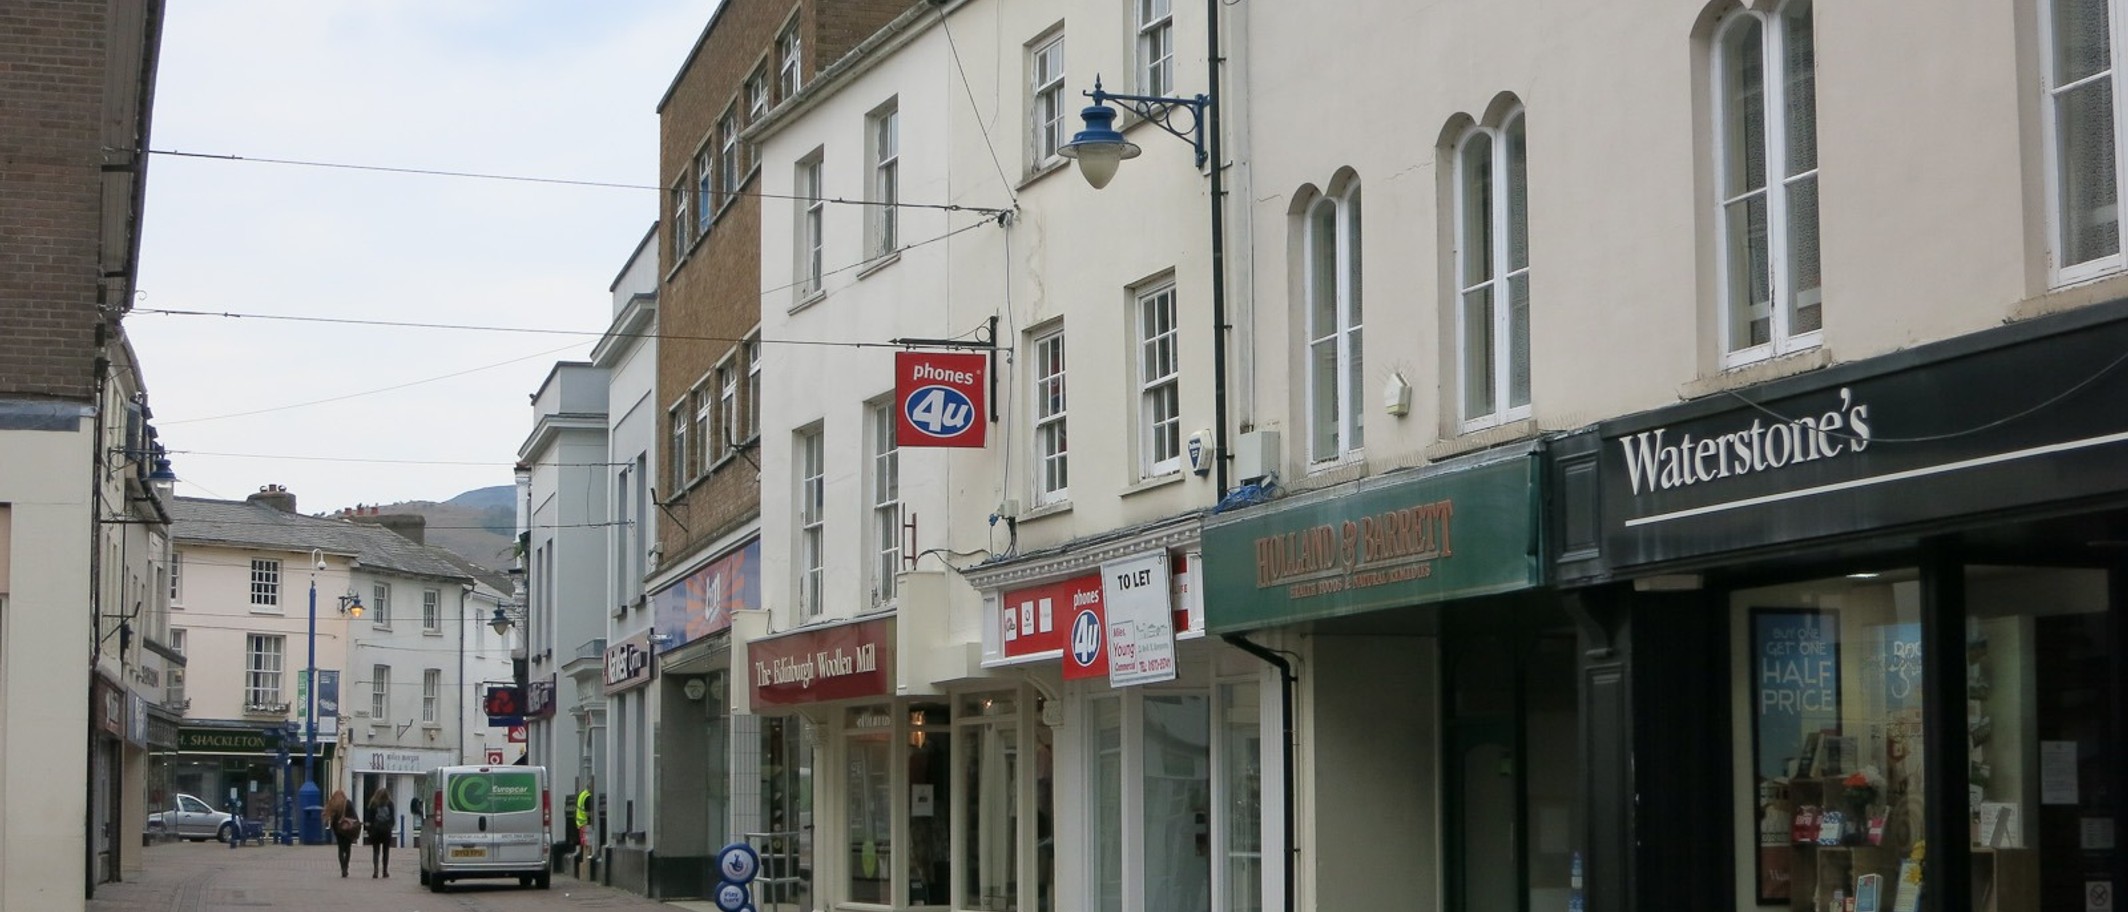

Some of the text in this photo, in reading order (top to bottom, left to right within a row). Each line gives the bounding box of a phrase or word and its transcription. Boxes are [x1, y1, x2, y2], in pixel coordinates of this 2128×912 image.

[913, 362, 974, 385] phones
[912, 389, 969, 432] 4u
[1619, 387, 1871, 496] Waterstone's
[1255, 499, 1454, 588] HOLLAND & BARRETT
[1118, 569, 1151, 590] TO LET
[1073, 589, 1099, 610] phones
[1074, 613, 1099, 662] 4u
[1773, 628, 1819, 640] BUY ONE
[1113, 642, 1135, 658] Young
[1767, 641, 1827, 656] GET ONE
[756, 643, 877, 689] The Edinburgh Woollen Mill
[1762, 657, 1832, 687] HALF
[1761, 690, 1835, 715] PRICE
[190, 735, 266, 747] SHACKLETON
[492, 785, 528, 795] Europcar
